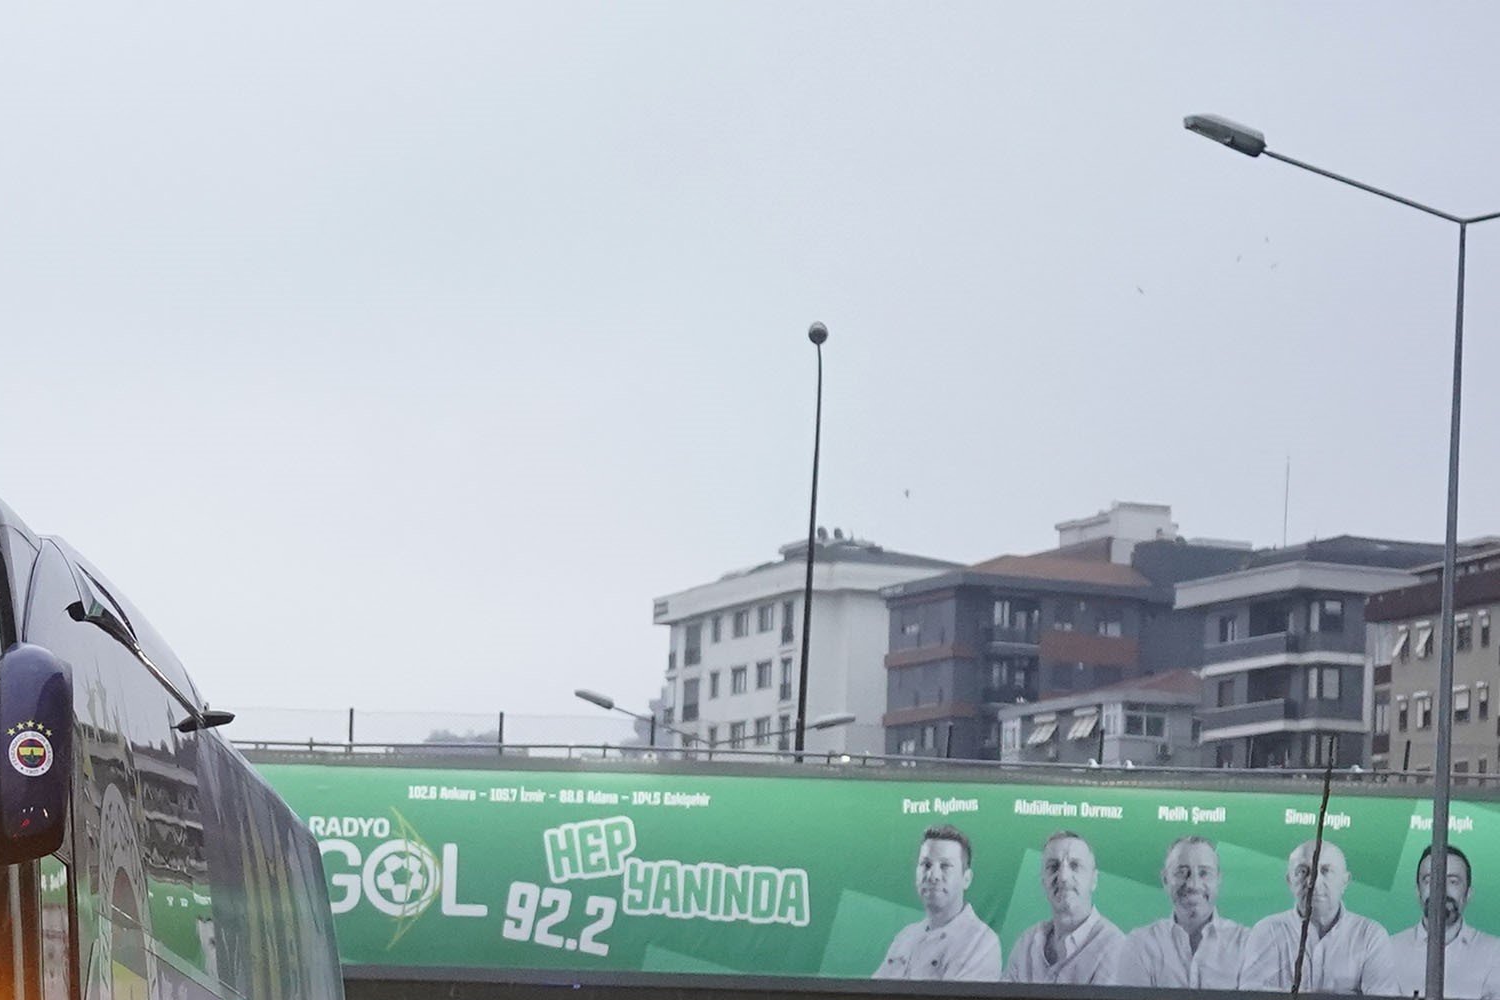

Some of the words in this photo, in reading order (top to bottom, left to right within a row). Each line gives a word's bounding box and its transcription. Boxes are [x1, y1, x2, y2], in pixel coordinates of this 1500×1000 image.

[309, 816, 390, 838] RADYO
[543, 815, 636, 884] HEP
[1411, 815, 1434, 831] Mur
[318, 839, 488, 917] GOL
[623, 857, 810, 927] YANINDA
[502, 881, 617, 957] 92.2
